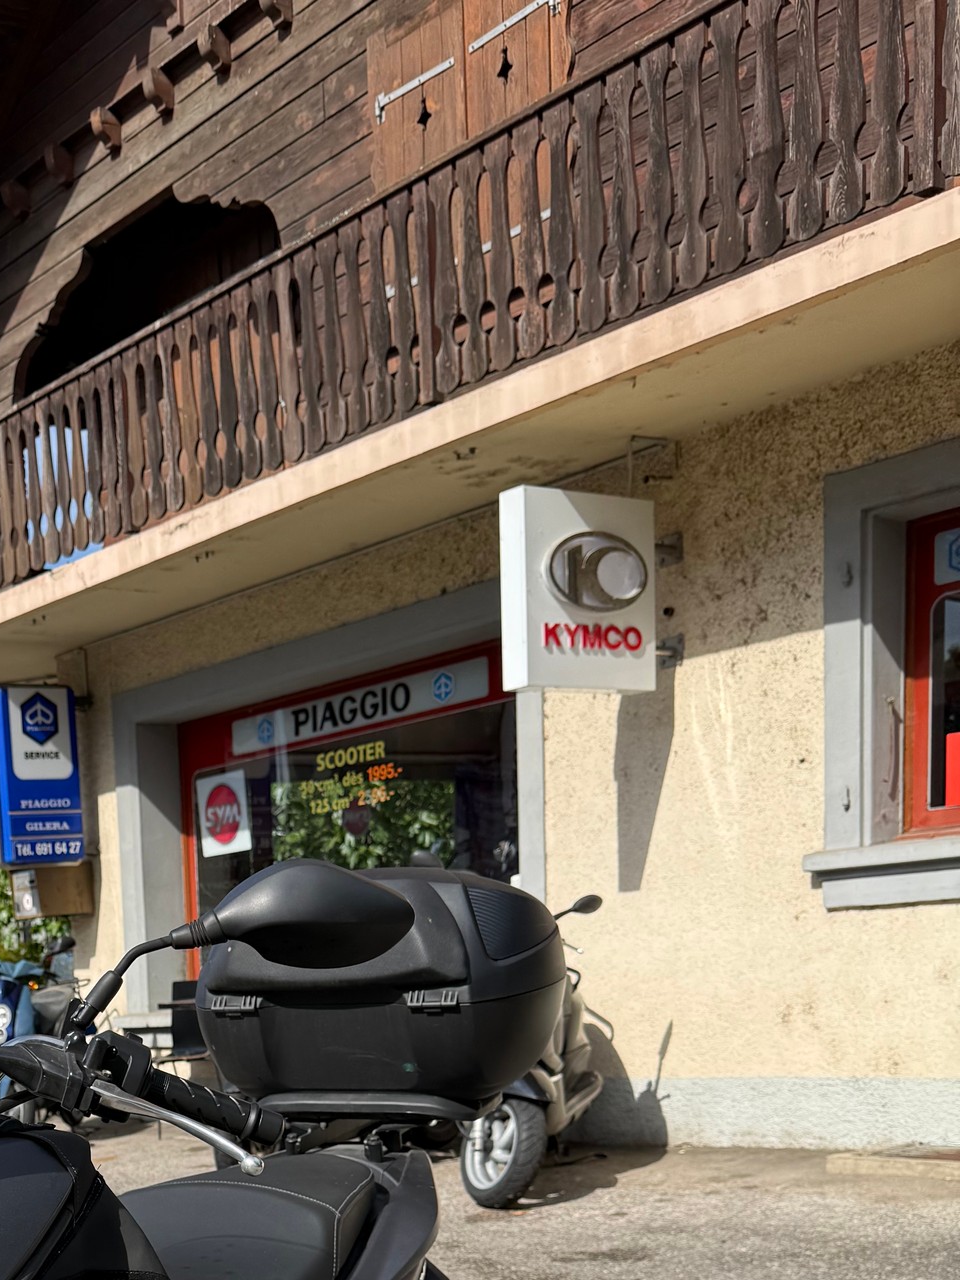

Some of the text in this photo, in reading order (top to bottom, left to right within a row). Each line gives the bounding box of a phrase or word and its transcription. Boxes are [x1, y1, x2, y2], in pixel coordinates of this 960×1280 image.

[542, 622, 643, 652] KYMCO
[291, 682, 411, 737] PIAGGIO
[24, 751, 61, 760] SERVICE
[316, 740, 386, 772] SCOOTER
[342, 771, 363, 787] dès
[367, 762, 403, 782] 1995.-
[20, 798, 71, 809] PIAGGIO
[309, 798, 330, 815] 125
[25, 821, 70, 832] GILERA
[206, 803, 242, 833] SYM
[35, 842, 52, 855] 691
[54, 842, 67, 854] 64
[68, 841, 82, 854] 27
